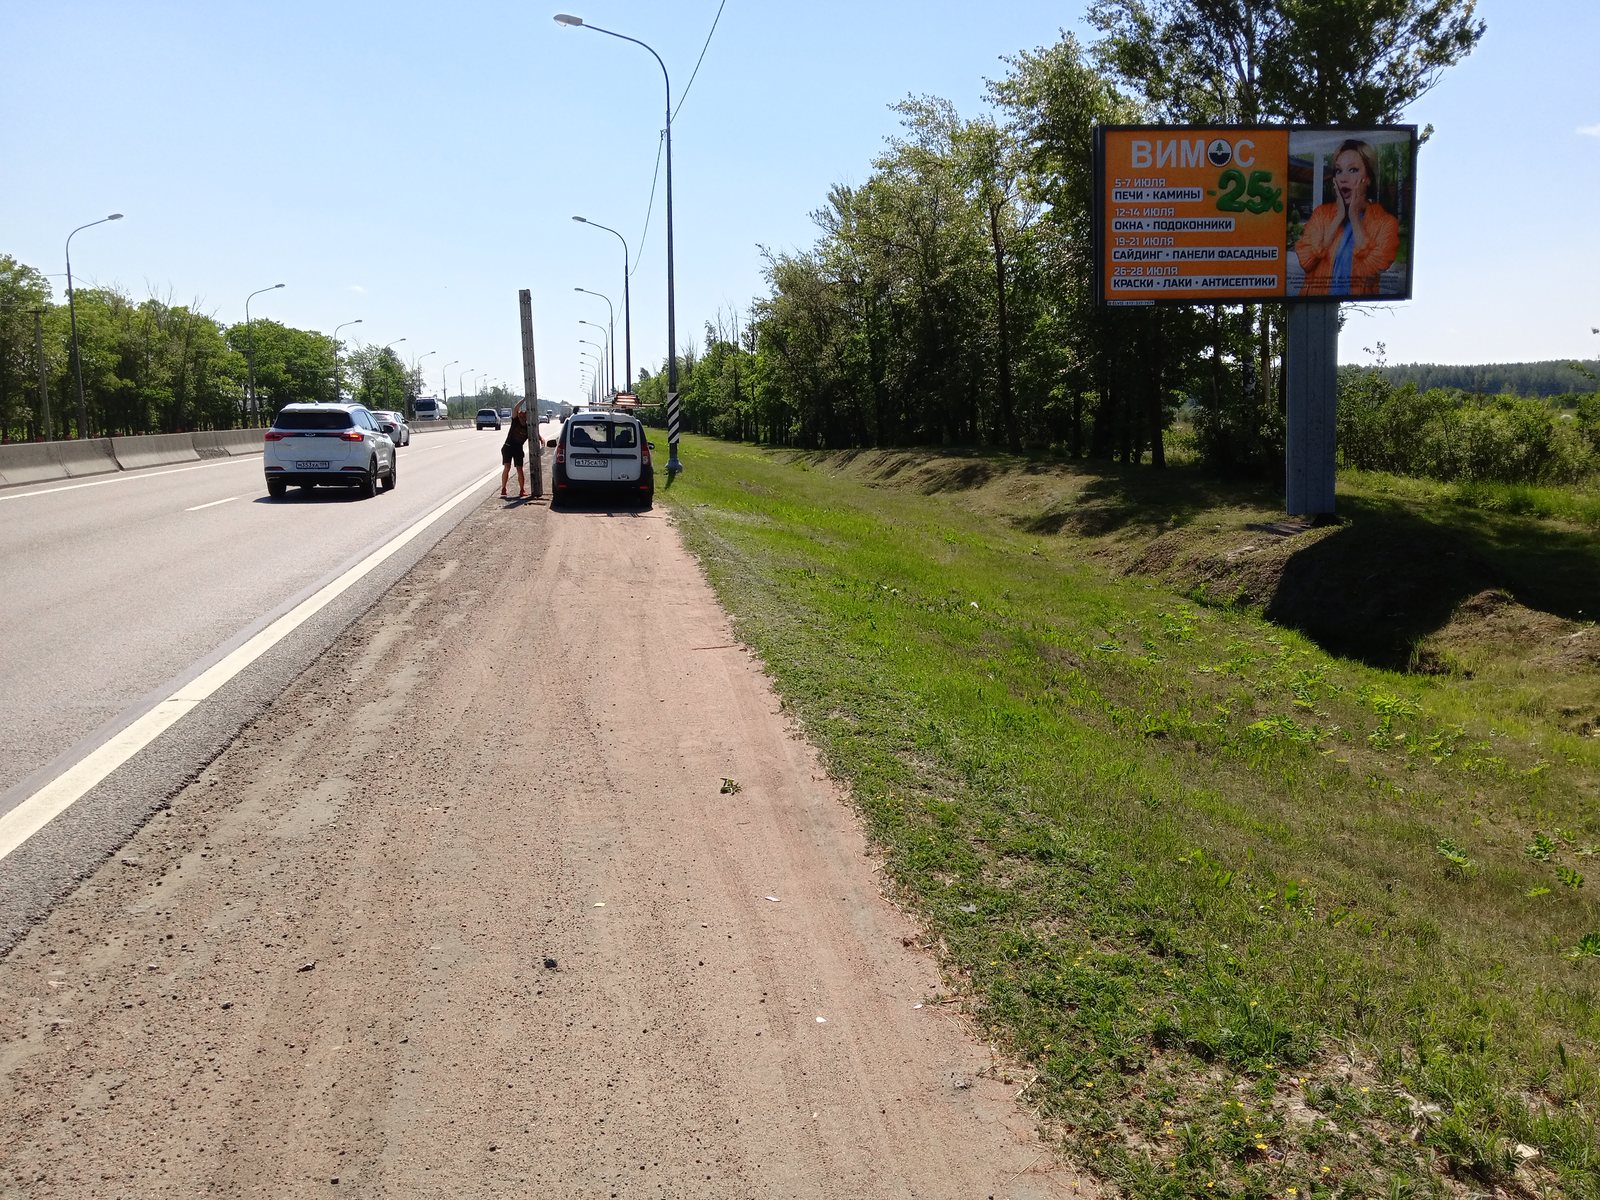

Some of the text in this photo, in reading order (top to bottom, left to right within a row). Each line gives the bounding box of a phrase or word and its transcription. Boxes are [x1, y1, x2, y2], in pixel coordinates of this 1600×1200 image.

[1131, 139, 1255, 168] ВИМОС
[1114, 178, 1166, 188] 5-7 ИЮЛЯ
[1114, 190, 1201, 200] ПЕЧИ КАМИНЫ
[1207, 169, 1283, 214] -25%
[1115, 207, 1175, 217] 12-14 ИЮЛЯ
[1114, 220, 1232, 231] ОКНА ПОДОКОННИКИ
[1114, 236, 1174, 246] 19-21 ИЮЛЯ
[1113, 248, 1278, 260] САЙДИНГ ПАНЕЛИ ФАСАДНЫЕ
[1114, 266, 1178, 276] 26-28 ИЮЛЯ
[1113, 279, 1154, 288] КРАСКИ
[1162, 278, 1192, 288] ЛАКИ
[1201, 277, 1276, 287] АНТИСЕПТИКИ
